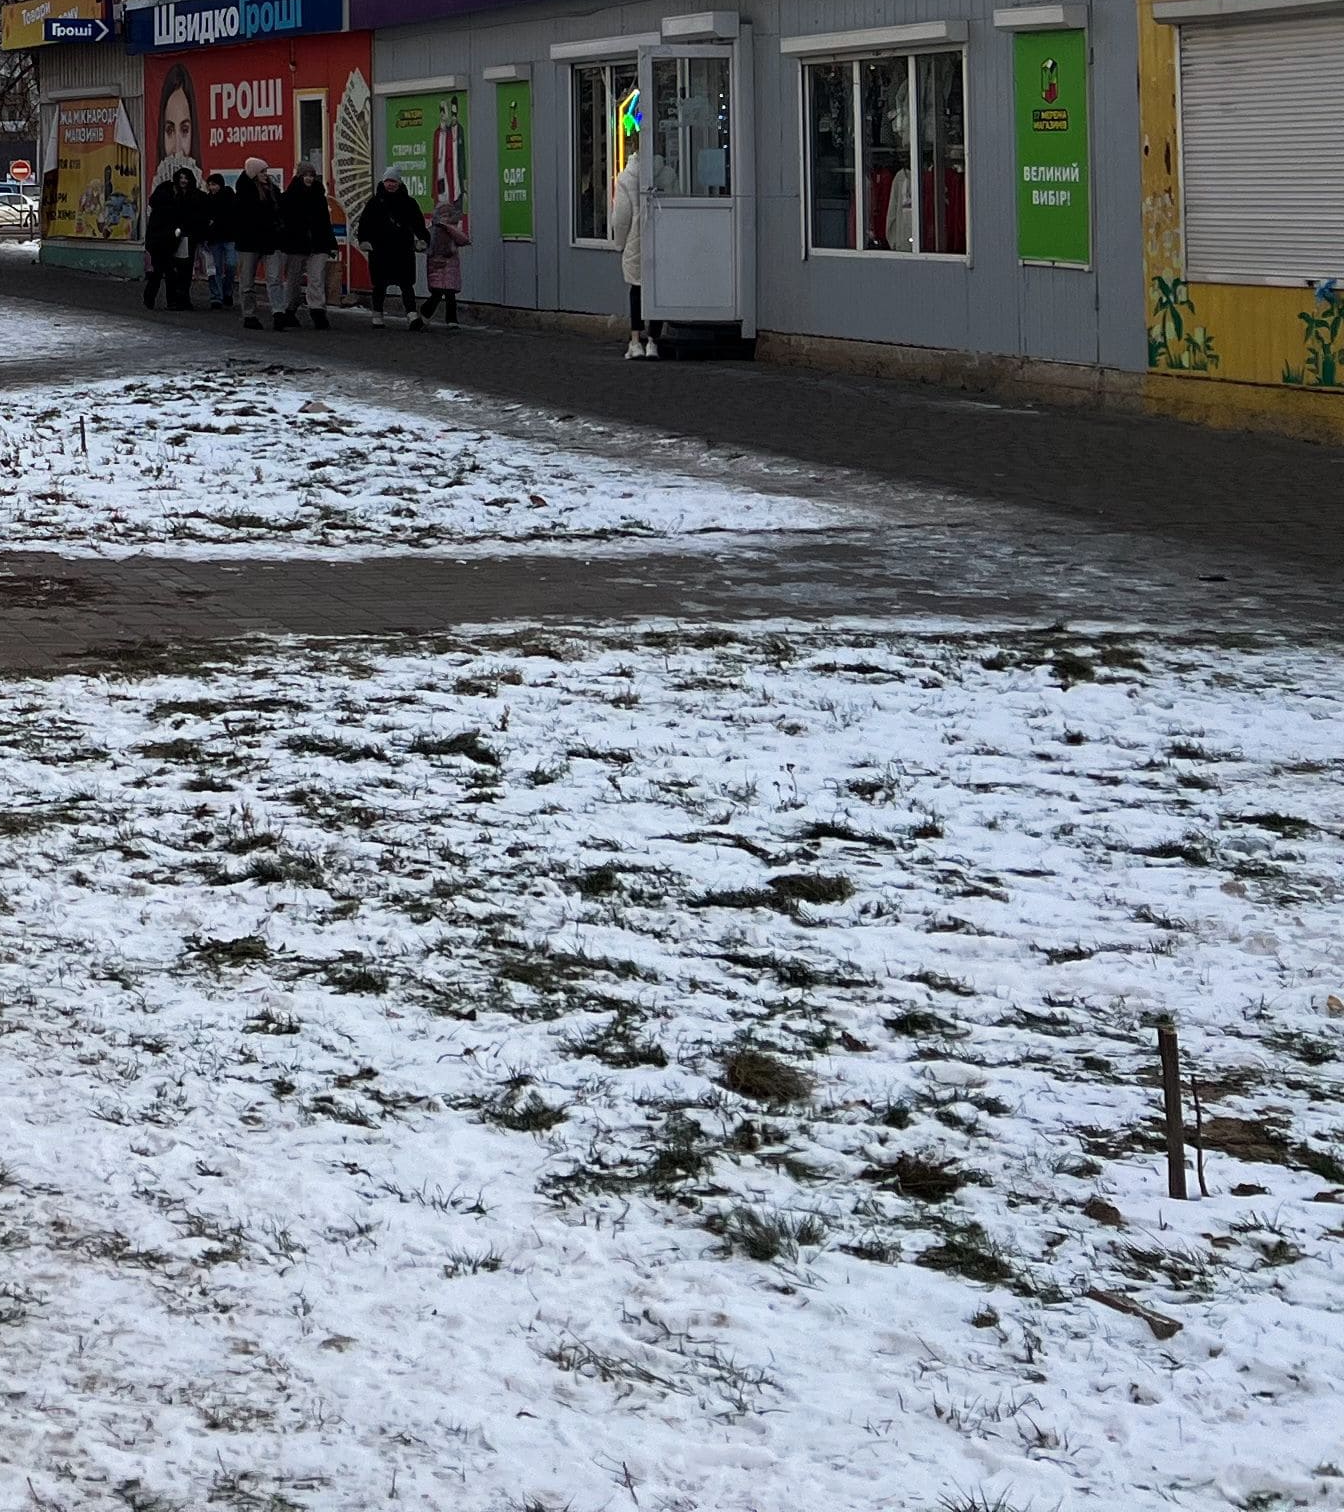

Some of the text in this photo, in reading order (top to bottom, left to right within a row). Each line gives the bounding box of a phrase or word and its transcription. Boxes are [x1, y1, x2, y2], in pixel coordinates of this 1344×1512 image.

[52, 23, 92, 37] Гроші
[210, 78, 283, 120] ГРОШІ
[210, 124, 283, 147] до зарплати
[503, 167, 526, 186] ОДЯГ
[1024, 162, 1080, 182] ВЕЛИКИЙ
[1032, 190, 1071, 206] ВИБІР!
